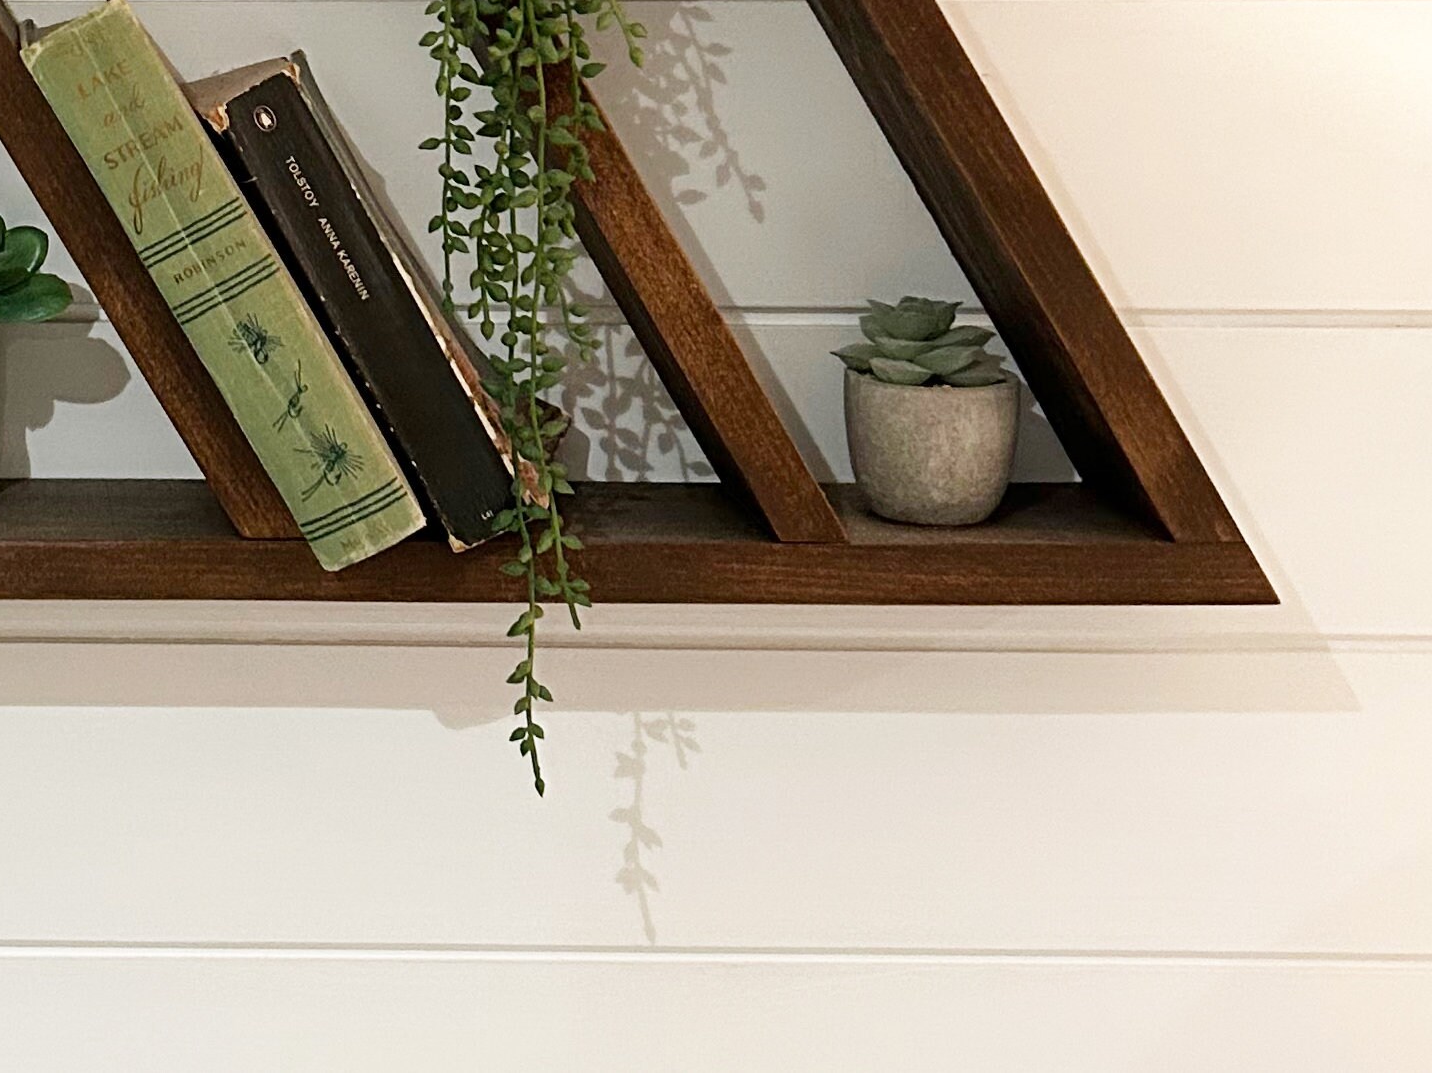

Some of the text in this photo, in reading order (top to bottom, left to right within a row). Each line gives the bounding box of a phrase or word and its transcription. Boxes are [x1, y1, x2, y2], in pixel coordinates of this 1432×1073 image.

[76, 58, 134, 102] LAKE
[103, 84, 145, 127] and
[103, 117, 185, 170] STREAM
[284, 155, 370, 301] TOLSTOY ANNA KARENIN
[172, 238, 248, 285] ROBINSON
